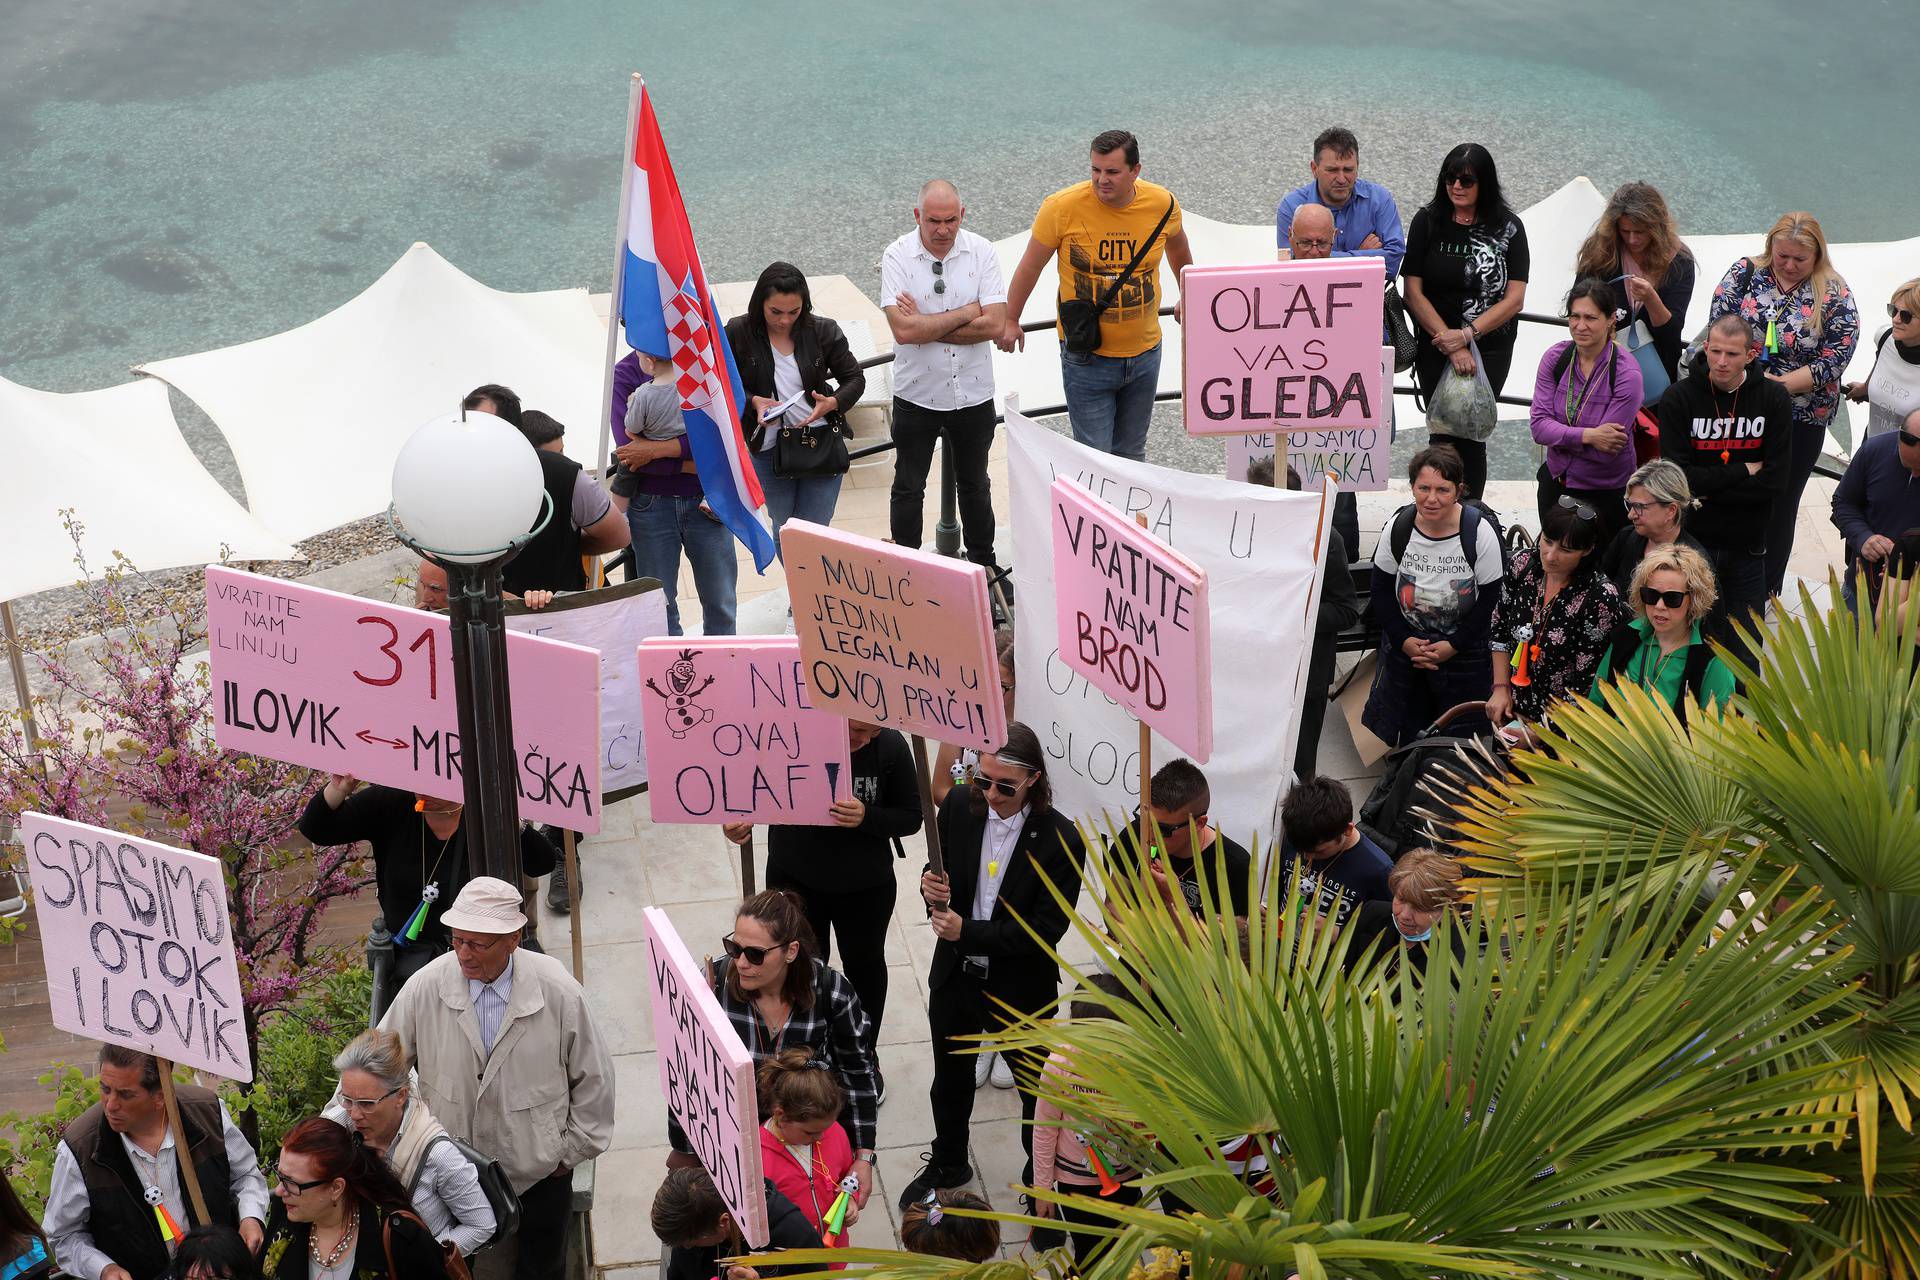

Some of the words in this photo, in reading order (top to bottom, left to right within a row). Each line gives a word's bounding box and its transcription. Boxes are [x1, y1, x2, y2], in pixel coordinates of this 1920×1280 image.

[1099, 240, 1137, 261] CITY
[1210, 281, 1363, 333] OLAF
[1233, 339, 1328, 371] VAS
[1200, 372, 1371, 421] GLEDA
[1244, 428, 1308, 449] NEO
[1312, 428, 1377, 450] SAMO
[1690, 417, 1735, 440] JUST
[1735, 416, 1766, 438] DO
[1249, 448, 1375, 484] TVAŠKA
[1229, 510, 1256, 559] U
[821, 555, 915, 607] MULIĆ
[1058, 502, 1193, 632] VRATITE
[1426, 565, 1466, 574] FASHION
[215, 581, 301, 619] VRATITE
[244, 612, 285, 635] NAM
[814, 594, 901, 641] JEDINI
[1103, 587, 1160, 657] NAM
[217, 627, 298, 665] LINIJU
[819, 626, 941, 679] LEGALAN
[1076, 611, 1167, 712] BROD
[750, 661, 815, 709] NE
[813, 660, 890, 721] OVOJ
[903, 684, 991, 745] PRIČI!
[224, 679, 346, 750] ILOVIK
[713, 722, 801, 760] OVAJ
[412, 725, 592, 817] MRŠKA
[34, 832, 225, 946] SPASIMO
[90, 921, 229, 1009] OTOK
[649, 937, 740, 1133] VRATITE
[674, 1035, 721, 1144] NAM
